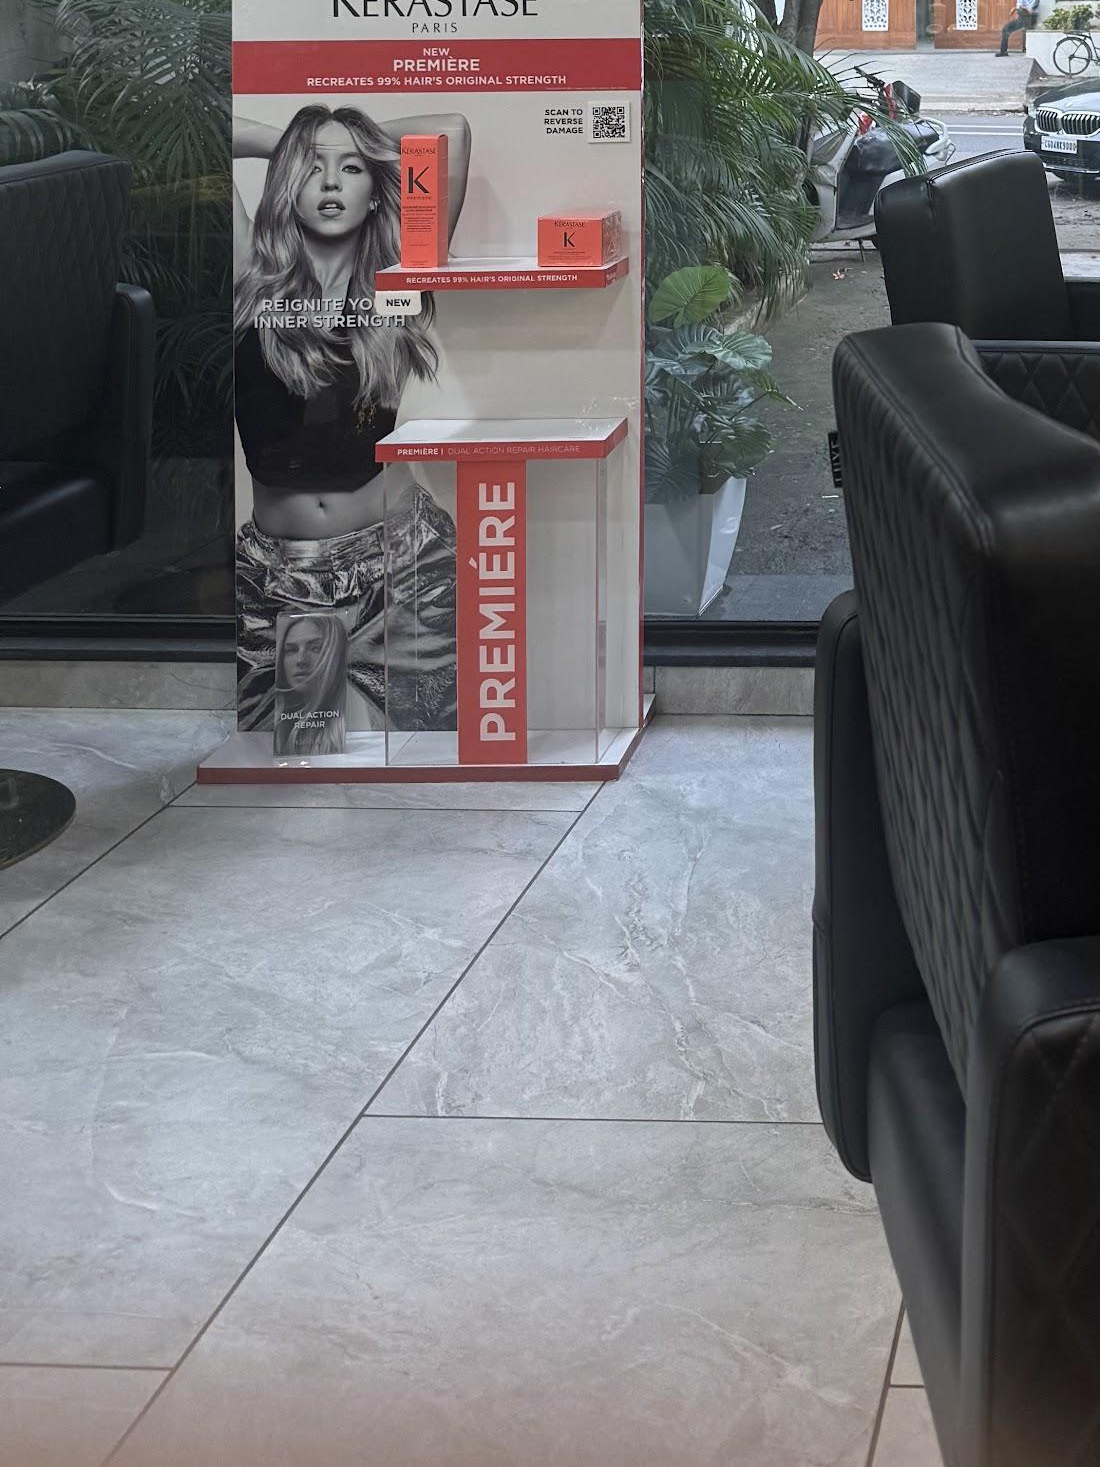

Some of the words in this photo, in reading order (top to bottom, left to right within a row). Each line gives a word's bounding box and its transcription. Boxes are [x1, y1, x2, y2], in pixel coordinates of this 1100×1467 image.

[412, 22, 459, 34] PARIS
[423, 47, 450, 57] NEW
[393, 56, 480, 72] PREMIÈRE
[307, 77, 374, 87] RECREATES
[377, 76, 401, 86] 99%
[404, 76, 442, 86] HAIR'S
[446, 76, 503, 86] ORIGINAL
[505, 75, 567, 85] STRENGTH
[544, 108, 569, 116] SCAN
[571, 108, 584, 116] TO
[543, 117, 584, 125] REVERSE
[545, 126, 584, 134] DAMAGE
[407, 166, 430, 194] K
[563, 231, 576, 247] K
[537, 274, 578, 282] STRENGTH
[262, 297, 344, 312] REIGNITE
[349, 297, 374, 312] YO
[386, 298, 411, 307] NEW
[254, 314, 309, 329] INNER
[313, 314, 406, 329] STRENGTH
[397, 446, 439, 456] PREMIÈRE
[448, 446, 472, 455] DUAL
[473, 446, 505, 455] ACTION
[506, 445, 537, 454] REPAIR
[537, 445, 581, 454] HAIRCARE
[280, 712, 305, 721] DUAL
[306, 710, 340, 720] ACTION
[294, 720, 326, 729] REPAIR
